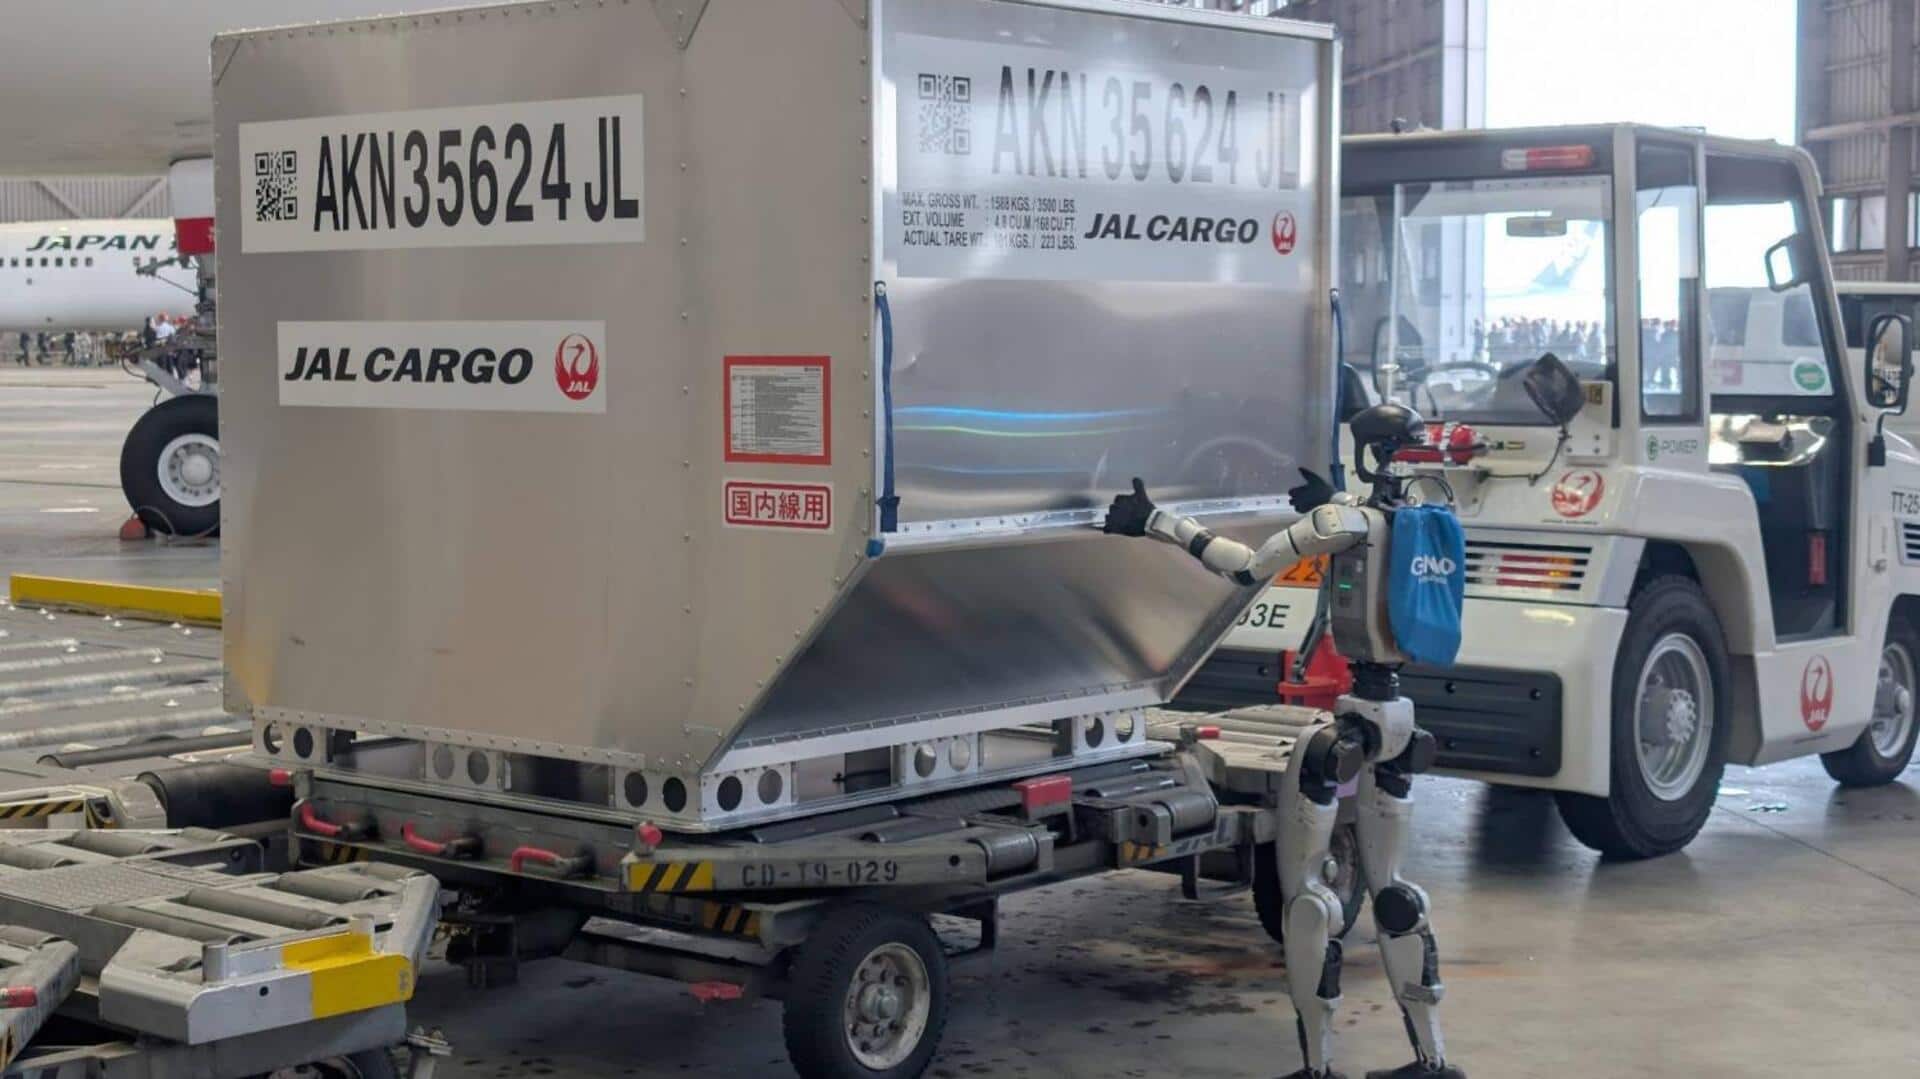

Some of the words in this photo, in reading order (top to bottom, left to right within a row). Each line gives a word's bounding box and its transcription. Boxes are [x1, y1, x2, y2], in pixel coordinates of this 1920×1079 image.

[928, 193, 961, 209] GROSS
[925, 211, 965, 228] VOLUME
[1084, 213, 1142, 240] JAL
[1146, 215, 1260, 244] CARGO
[26, 234, 161, 251] JAPAN
[903, 230, 941, 247] ACTUAL
[943, 231, 967, 247] TARE
[285, 347, 358, 381] JAL
[363, 347, 534, 385] CARGO
[566, 380, 592, 393] JAL
[731, 489, 824, 522] 国内線用
[742, 861, 898, 887] CD-T9-029
